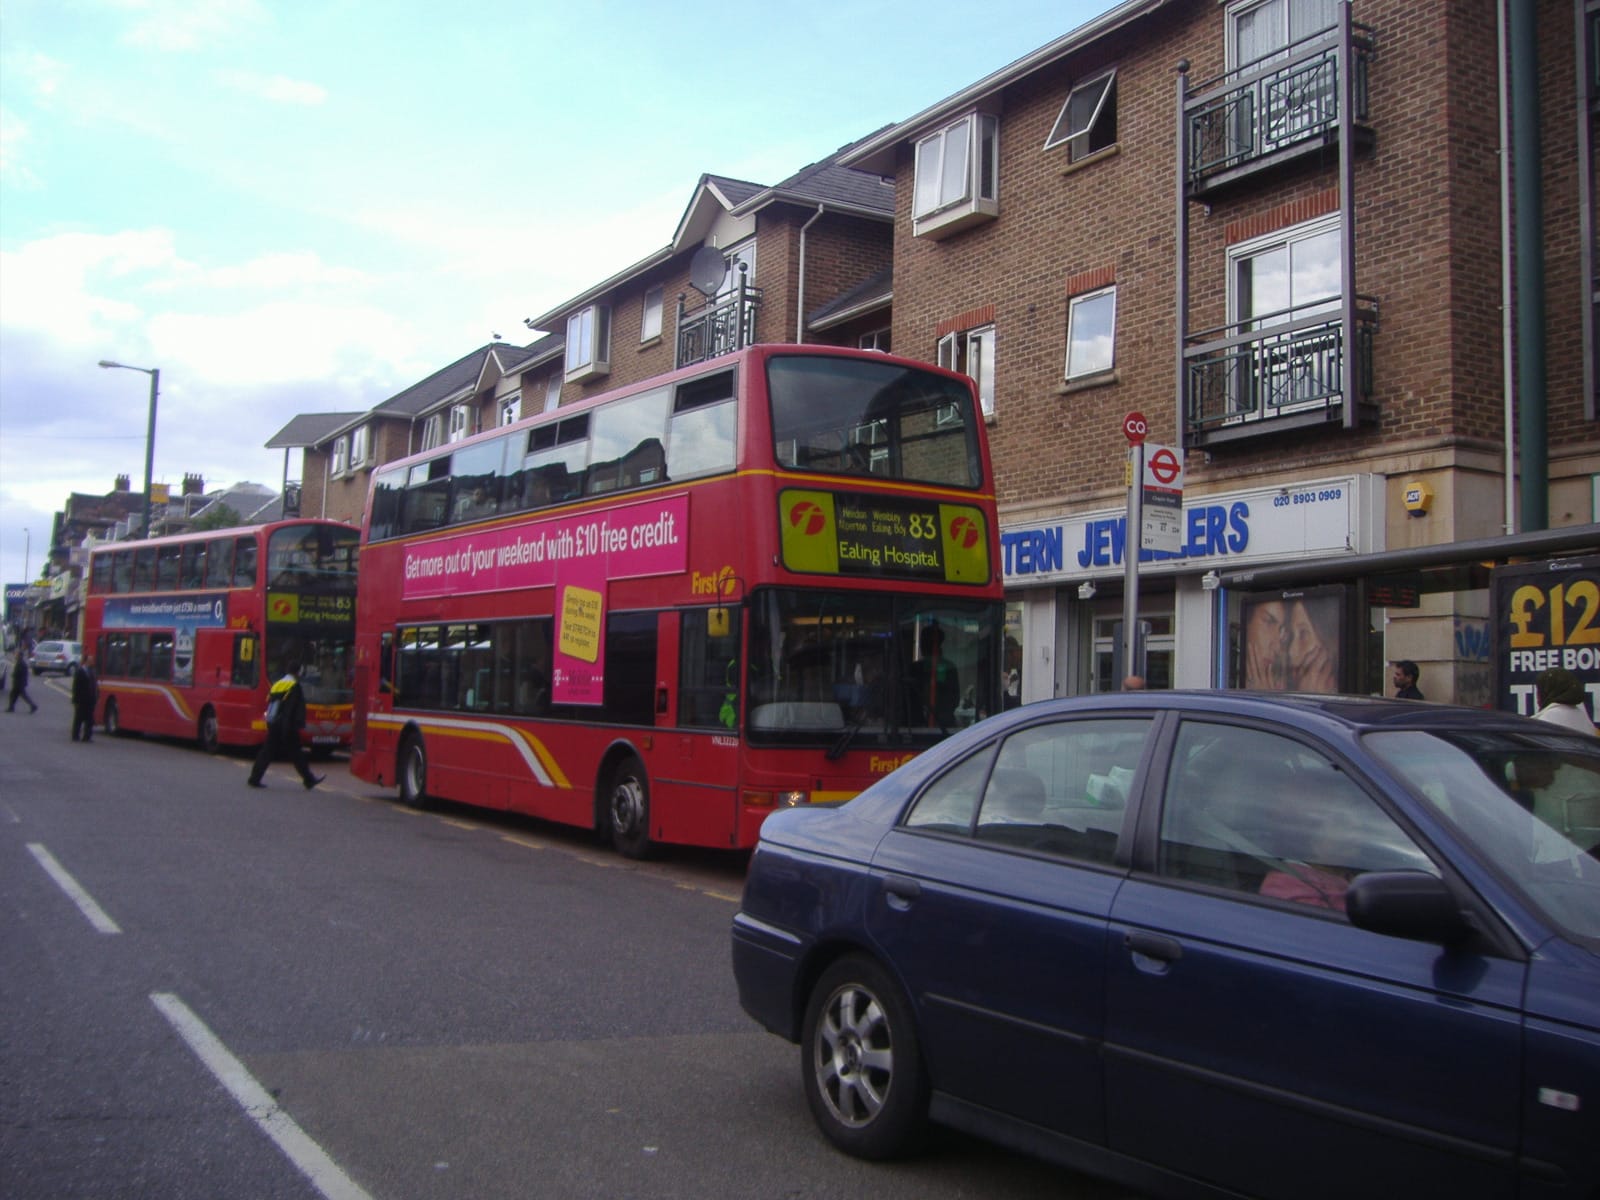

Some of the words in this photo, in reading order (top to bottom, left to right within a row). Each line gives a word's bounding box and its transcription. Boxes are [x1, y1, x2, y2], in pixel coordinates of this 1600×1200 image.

[1127, 420, 1146, 434] CQ
[1273, 495, 1290, 507] 020
[1293, 492, 1316, 505] 8903
[1318, 489, 1342, 502] 0909
[909, 513, 937, 539] 83
[405, 554, 420, 579] Get
[420, 556, 443, 576] more
[445, 550, 459, 575] out
[461, 544, 472, 572] of
[471, 548, 495, 577] your
[497, 532, 545, 567] weekend
[547, 528, 574, 560] with
[576, 522, 598, 557] £10
[600, 521, 628, 552] free
[631, 511, 678, 550] credit.
[840, 541, 881, 566] Ealing
[884, 545, 939, 568] Hospital
[692, 570, 718, 594] First
[336, 597, 352, 609] 83
[1510, 649, 1559, 672] FREE
[870, 755, 899, 772] First
